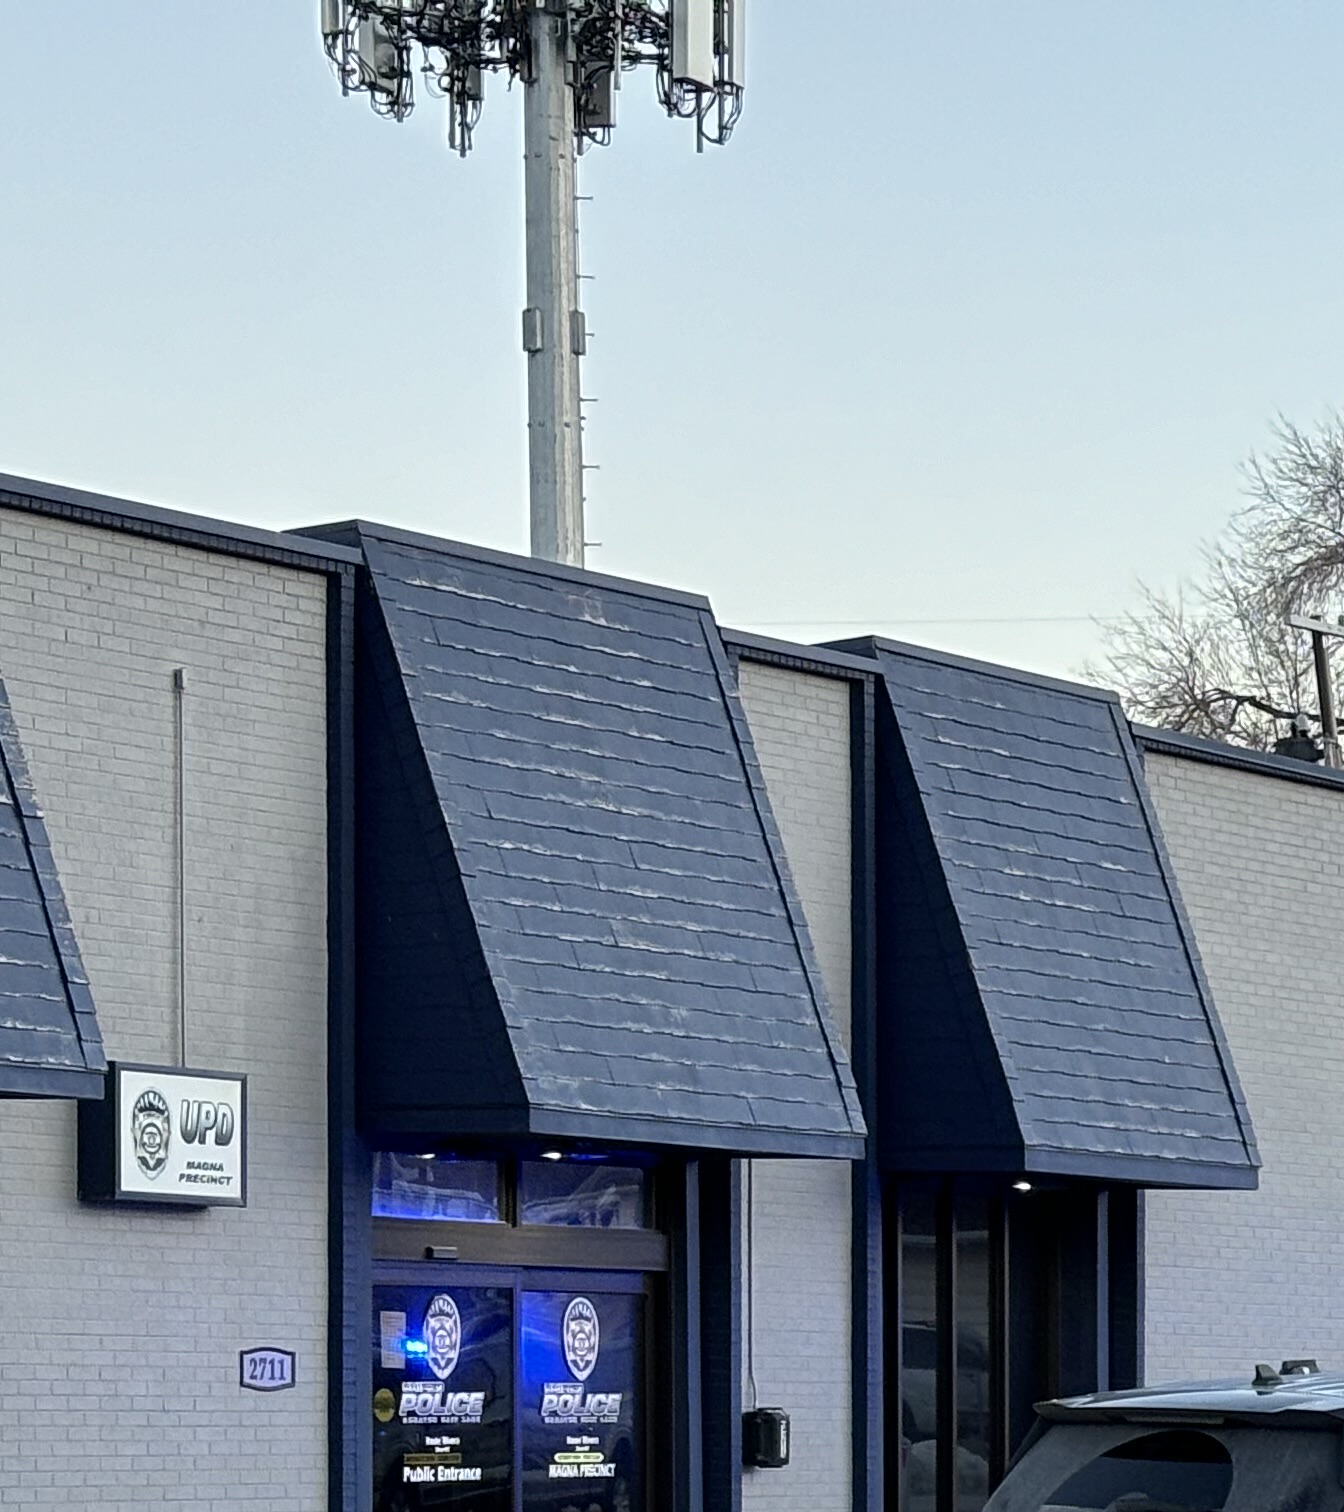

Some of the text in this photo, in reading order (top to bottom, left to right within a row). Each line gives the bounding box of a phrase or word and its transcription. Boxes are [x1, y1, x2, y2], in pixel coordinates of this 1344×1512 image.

[180, 1099, 235, 1147] UPD
[185, 1161, 225, 1172] MAGNA
[178, 1173, 234, 1186] PRECINCT
[249, 1357, 287, 1382] 2711
[399, 1391, 486, 1417] POLICE
[541, 1392, 623, 1417] POLICE
[403, 1466, 482, 1483] Public Entrance
